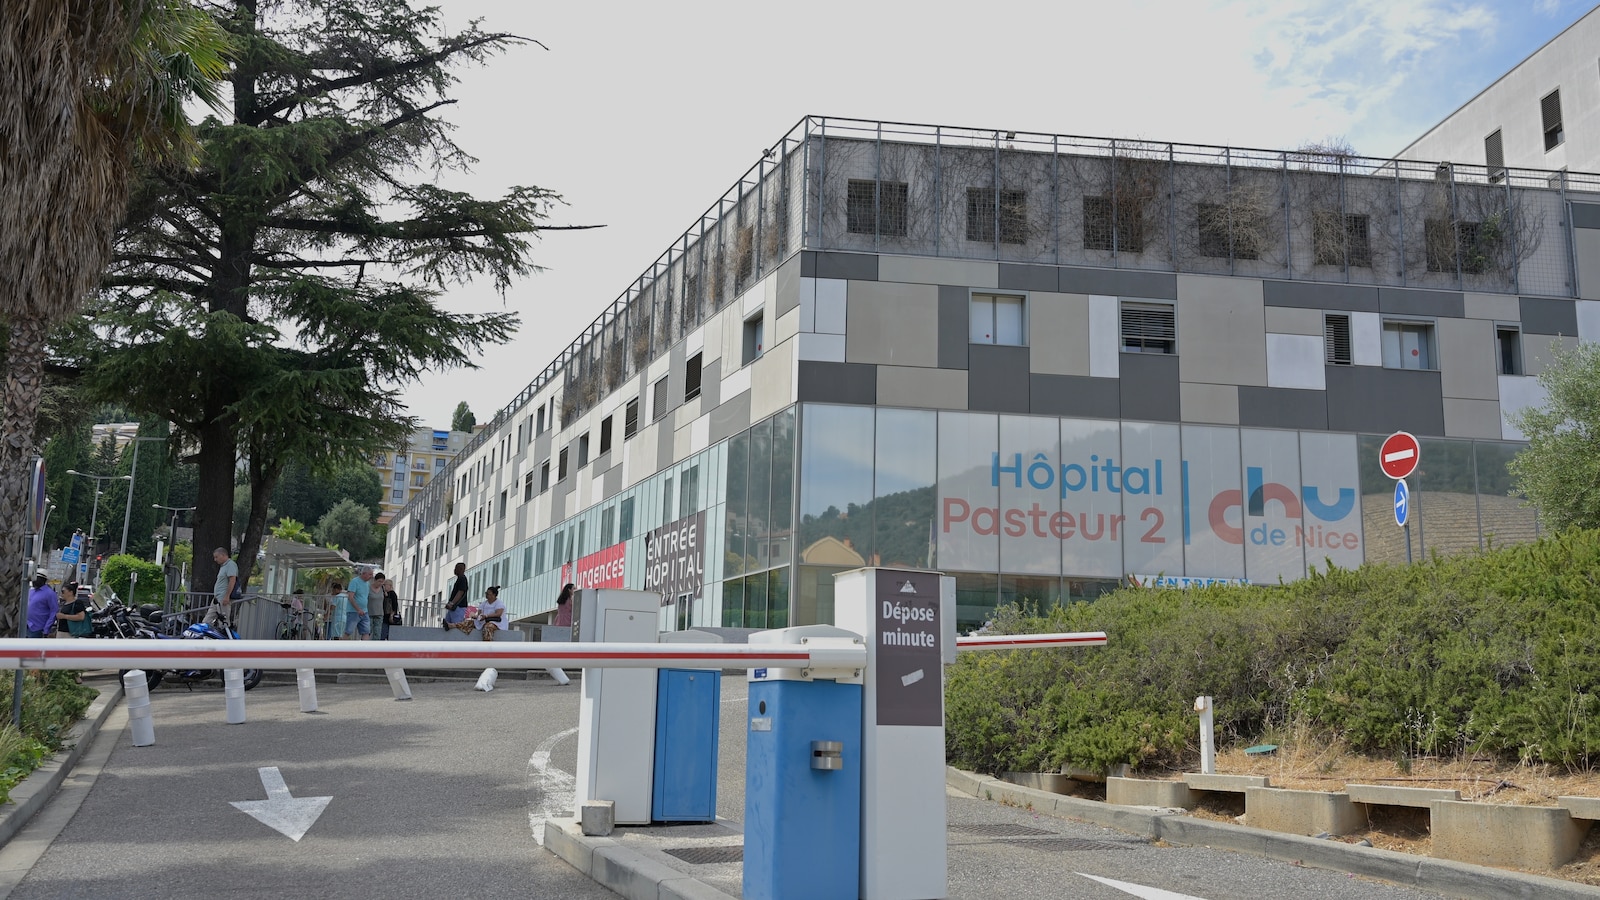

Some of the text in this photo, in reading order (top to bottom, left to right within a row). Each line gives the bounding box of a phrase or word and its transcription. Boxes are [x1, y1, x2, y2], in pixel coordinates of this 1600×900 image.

[991, 451, 1163, 499] Hôpital
[943, 497, 1166, 543] Pasteur 2
[1250, 522, 1359, 550] de Nice
[647, 521, 697, 561] ENTRÉE
[645, 551, 703, 589] HÔPITAL
[882, 600, 935, 625] Dépose
[882, 627, 935, 648] minute
